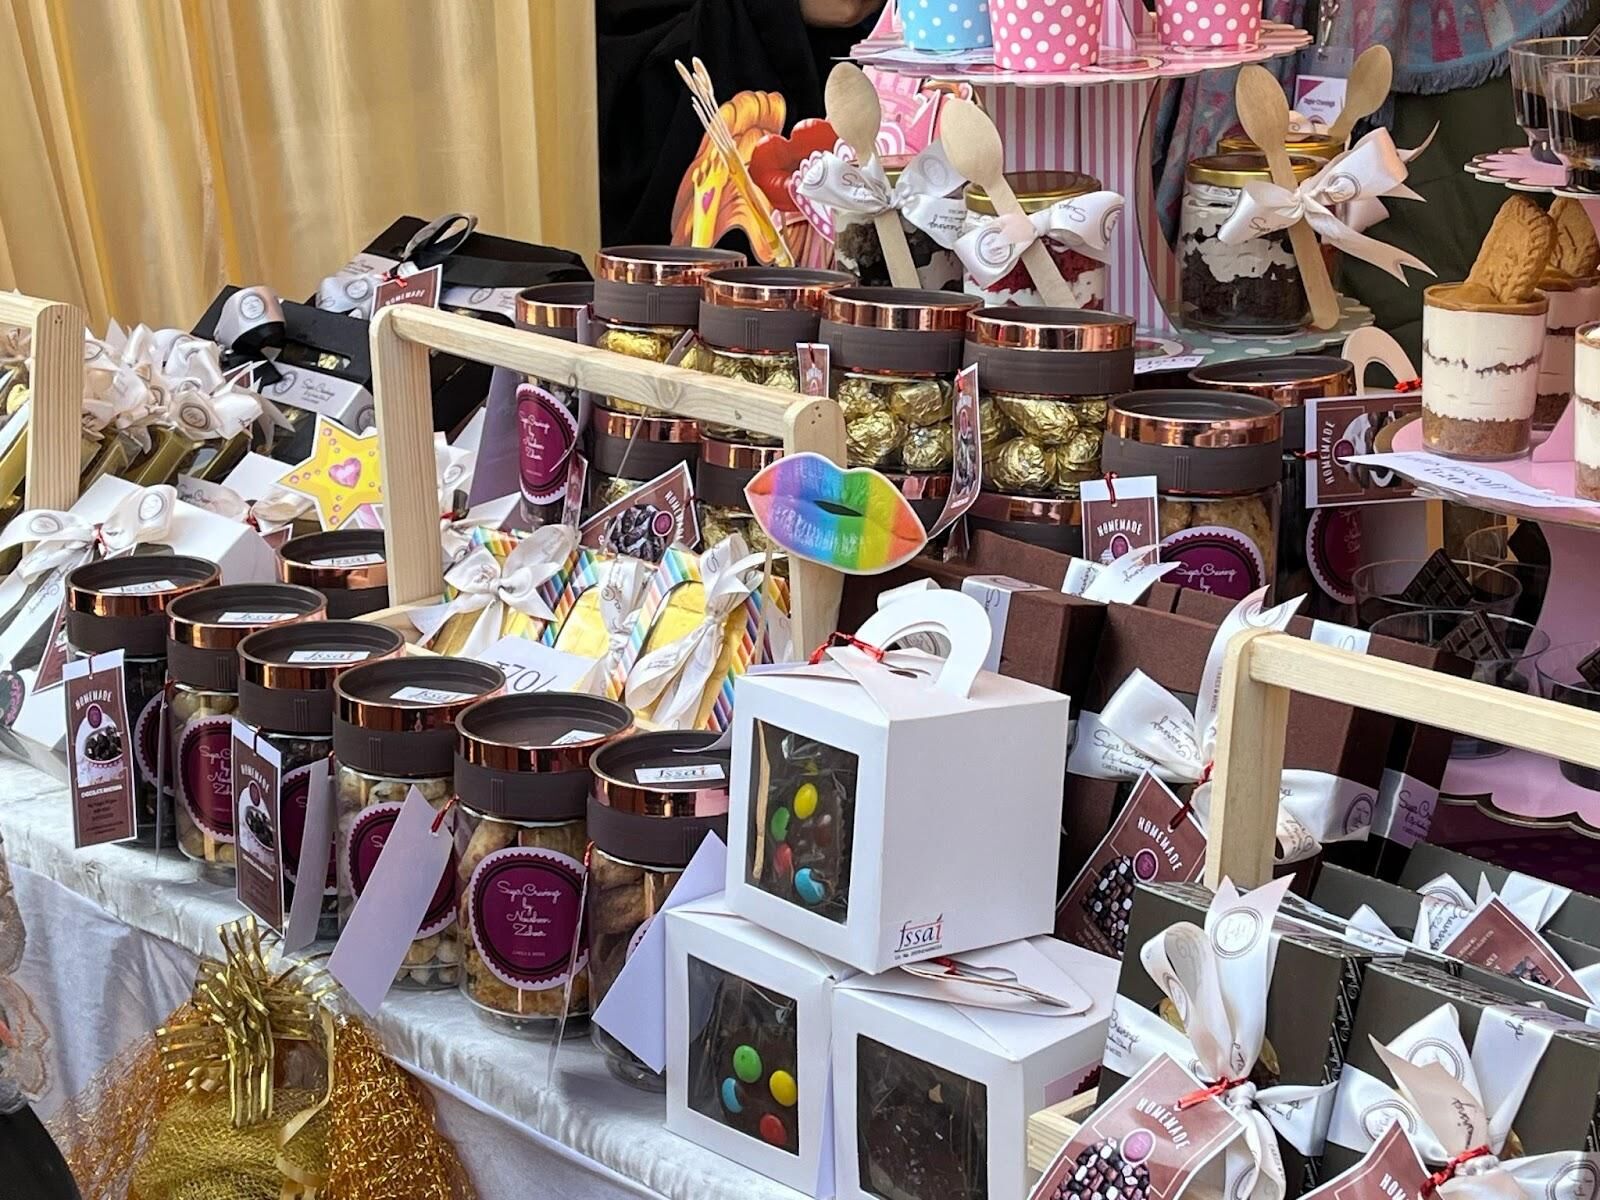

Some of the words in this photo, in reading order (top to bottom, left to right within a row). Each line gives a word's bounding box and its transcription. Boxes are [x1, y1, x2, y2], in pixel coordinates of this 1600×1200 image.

[385, 289, 426, 306] HOMEMADE
[1320, 420, 1336, 485] HOMEMADE
[1096, 518, 1143, 537] HOMEMADE
[75, 689, 113, 711] HOMEMADE
[240, 763, 270, 793] HOMEMADE
[1137, 816, 1183, 872] HOMEMADE
[894, 912, 944, 953] fssai
[1135, 1098, 1190, 1150] HOMEMADE
